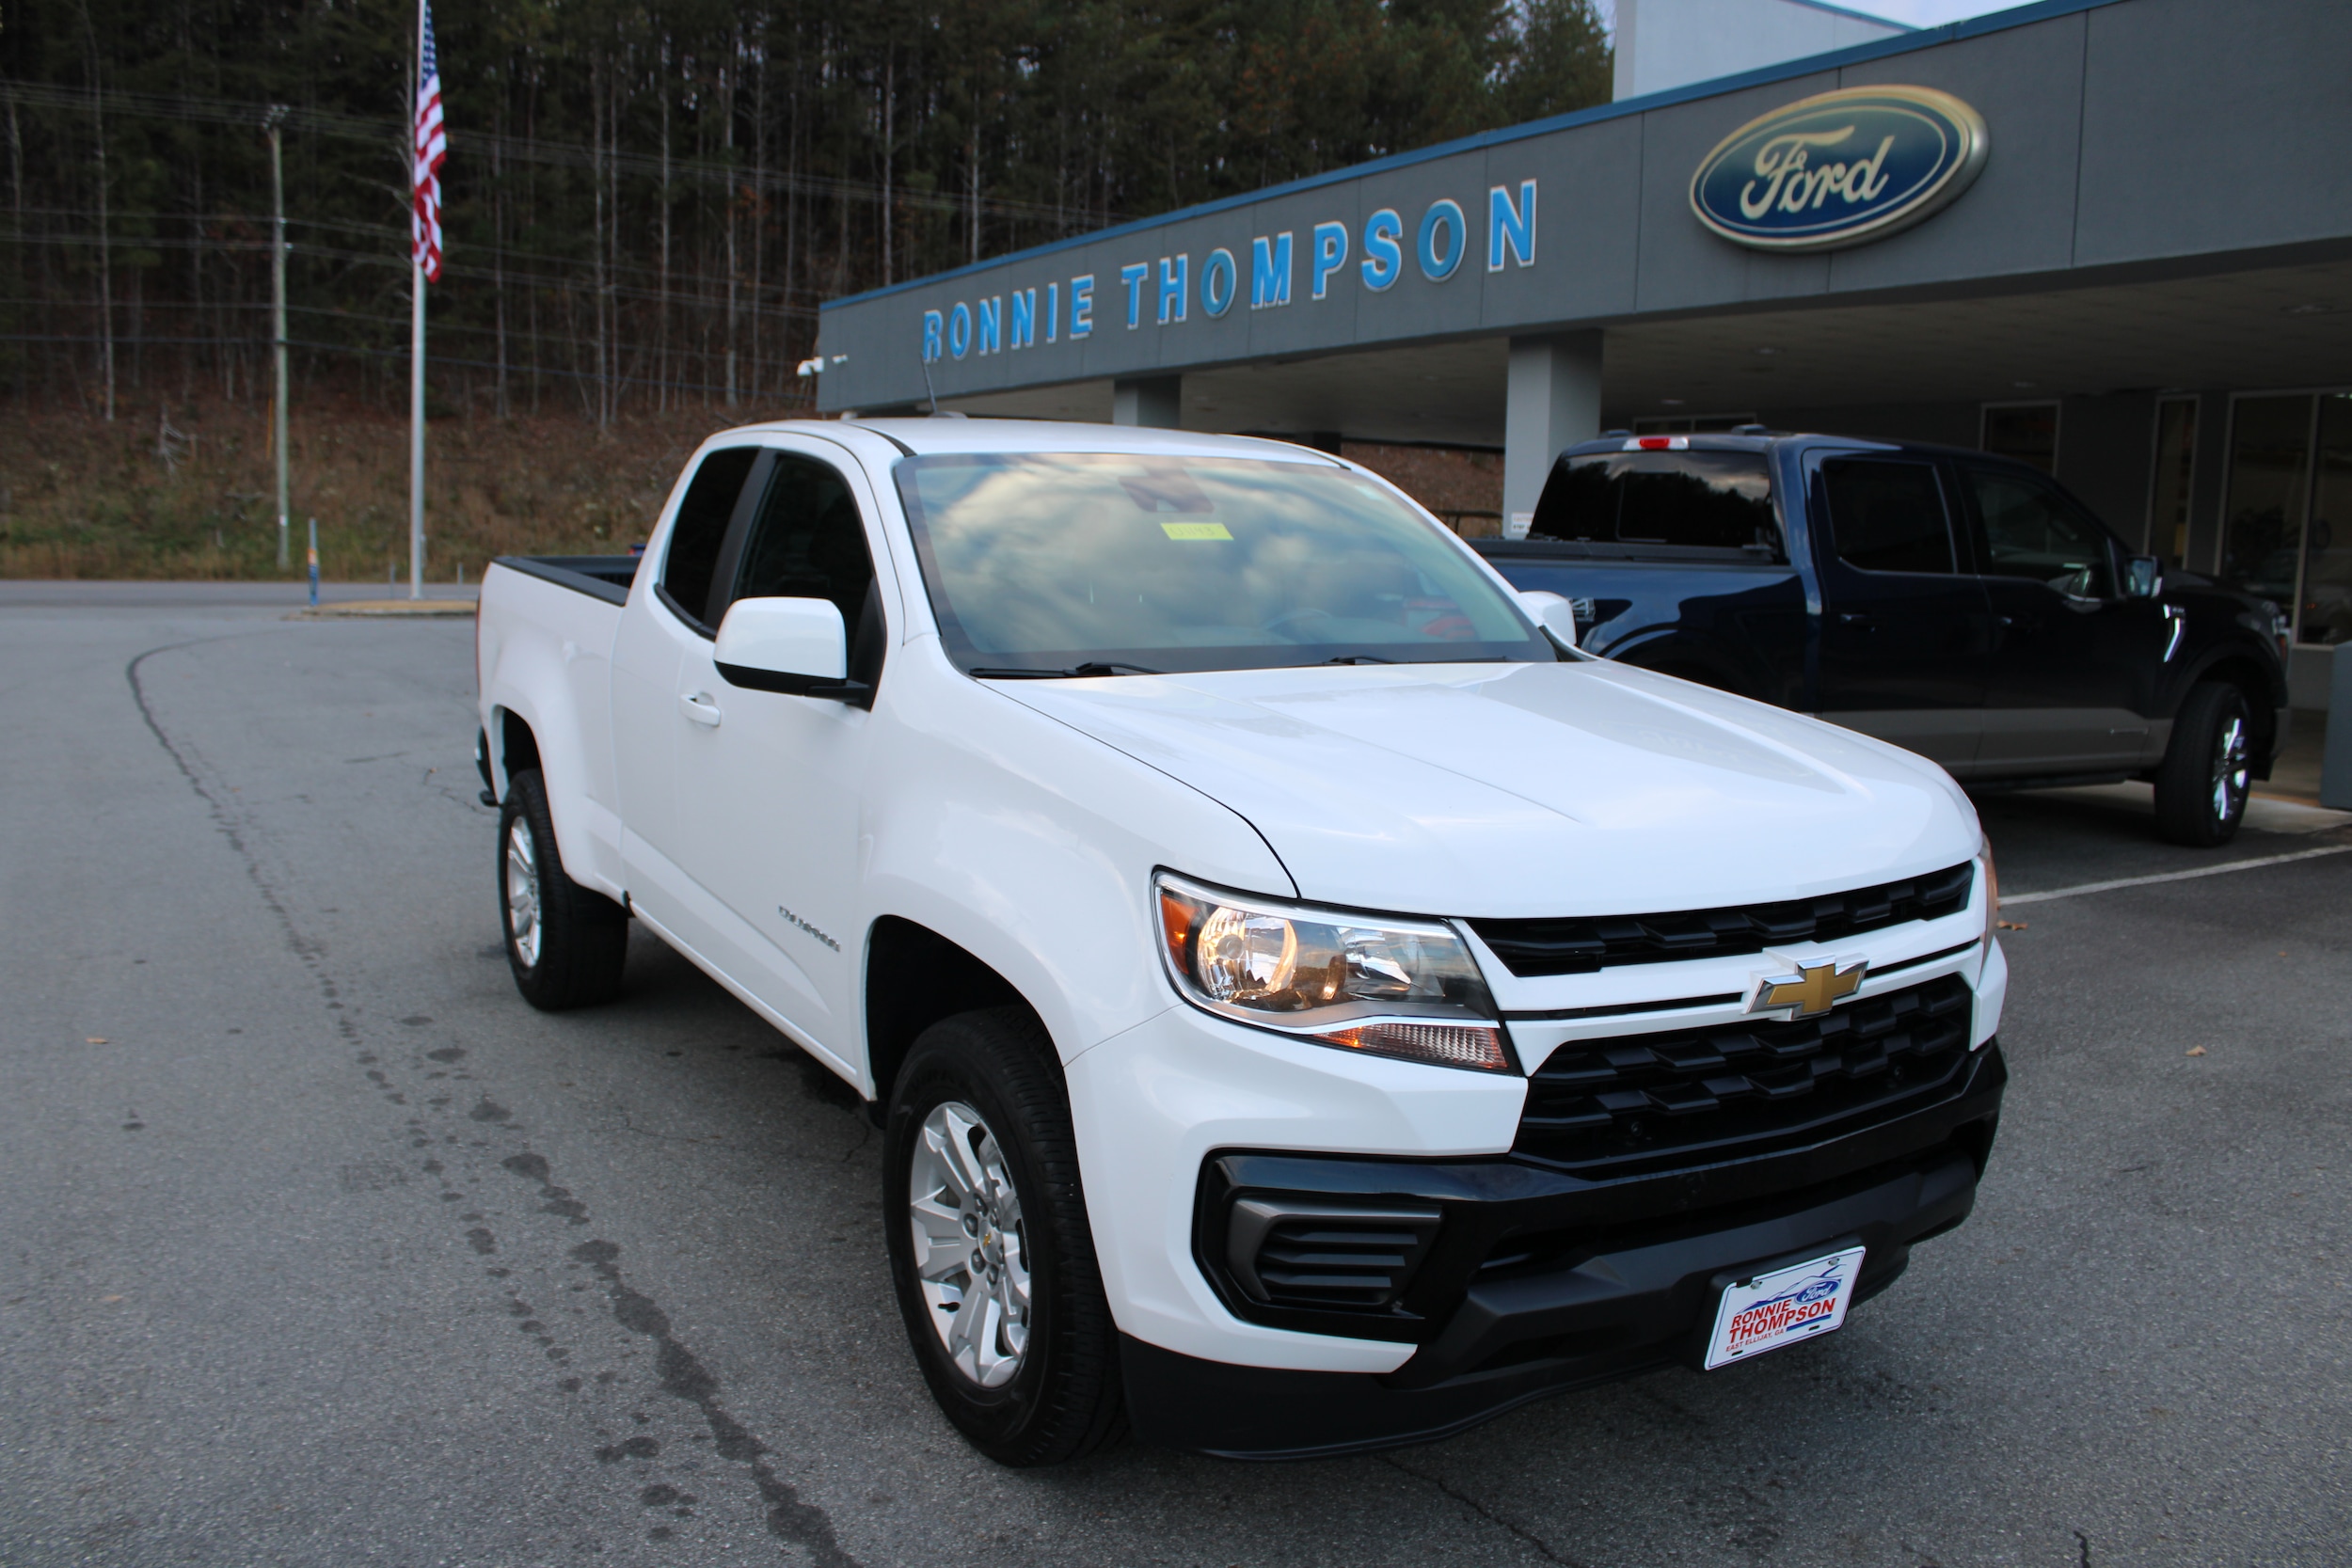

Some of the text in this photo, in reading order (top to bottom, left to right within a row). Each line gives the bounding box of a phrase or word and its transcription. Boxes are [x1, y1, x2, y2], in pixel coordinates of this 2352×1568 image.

[1740, 125, 1894, 219] Ford
[920, 179, 1537, 364] RONNIE THOMPSON
[1802, 1283, 1833, 1302] Ford
[1729, 1297, 1836, 1343] THOMPSON
[1731, 1299, 1792, 1328] RONNIE
[1725, 1328, 1785, 1352] EAST ELLIJAY, GA
